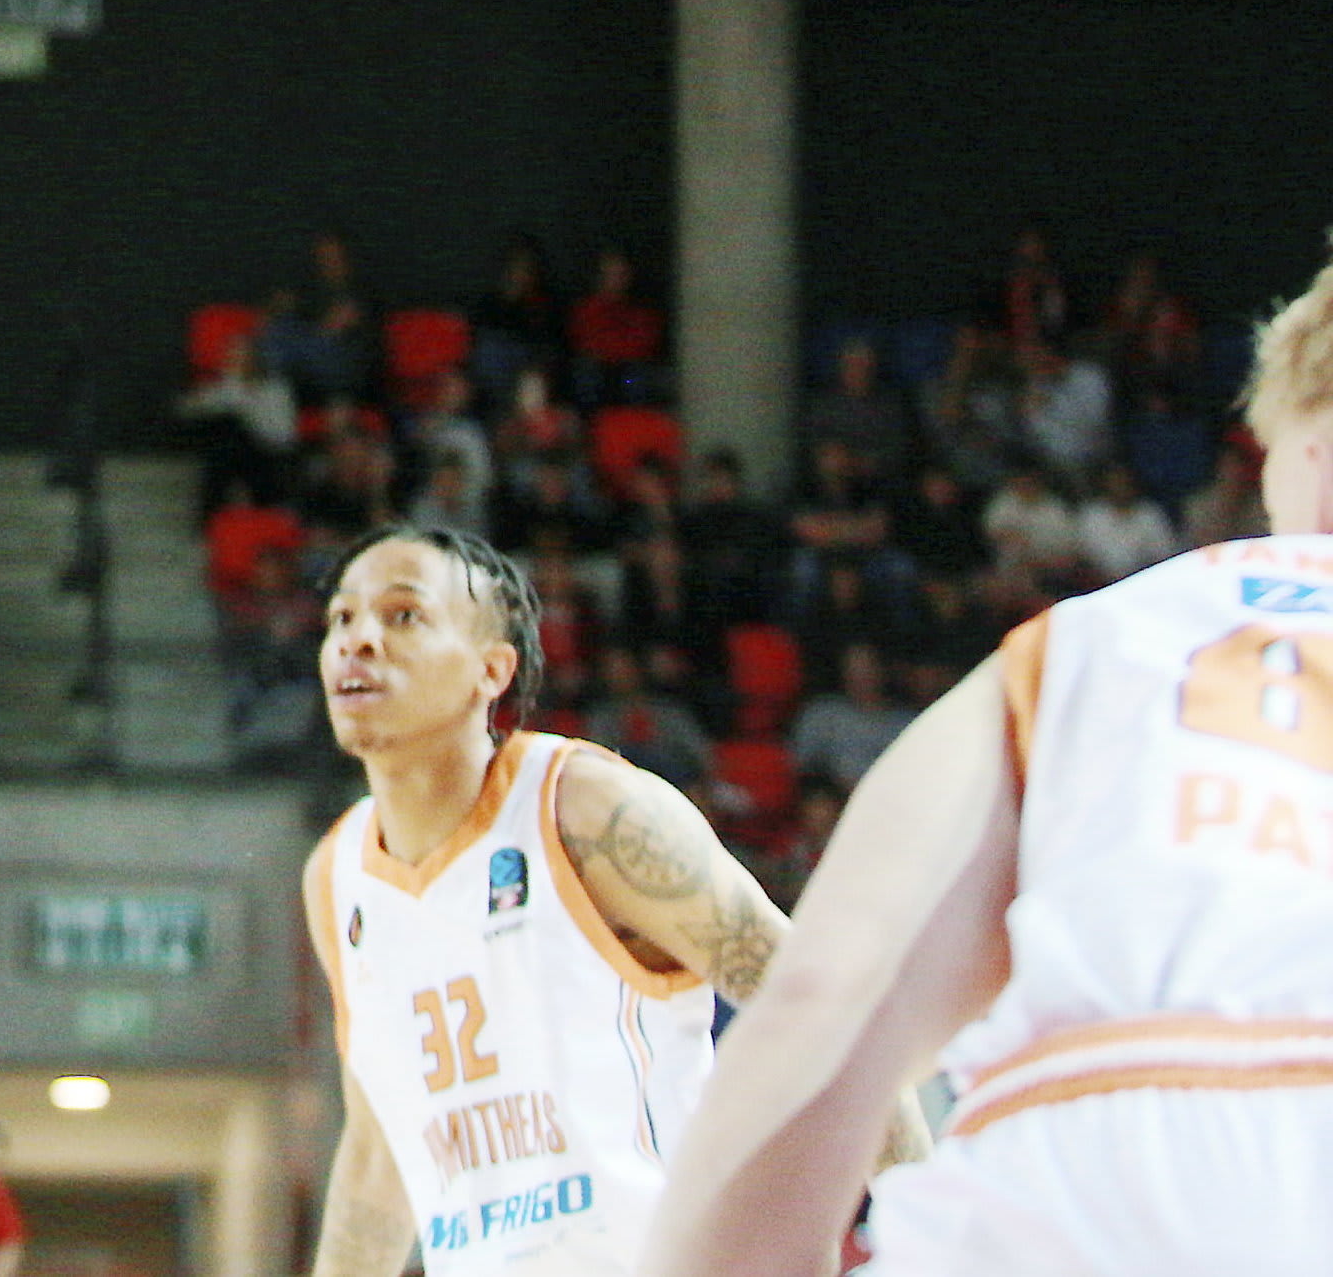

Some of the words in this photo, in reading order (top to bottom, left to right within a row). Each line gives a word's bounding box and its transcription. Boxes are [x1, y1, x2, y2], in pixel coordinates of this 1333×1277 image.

[1175, 772, 1333, 882] PA
[412, 975, 500, 1093] 32
[480, 1173, 593, 1240] FRIGO
